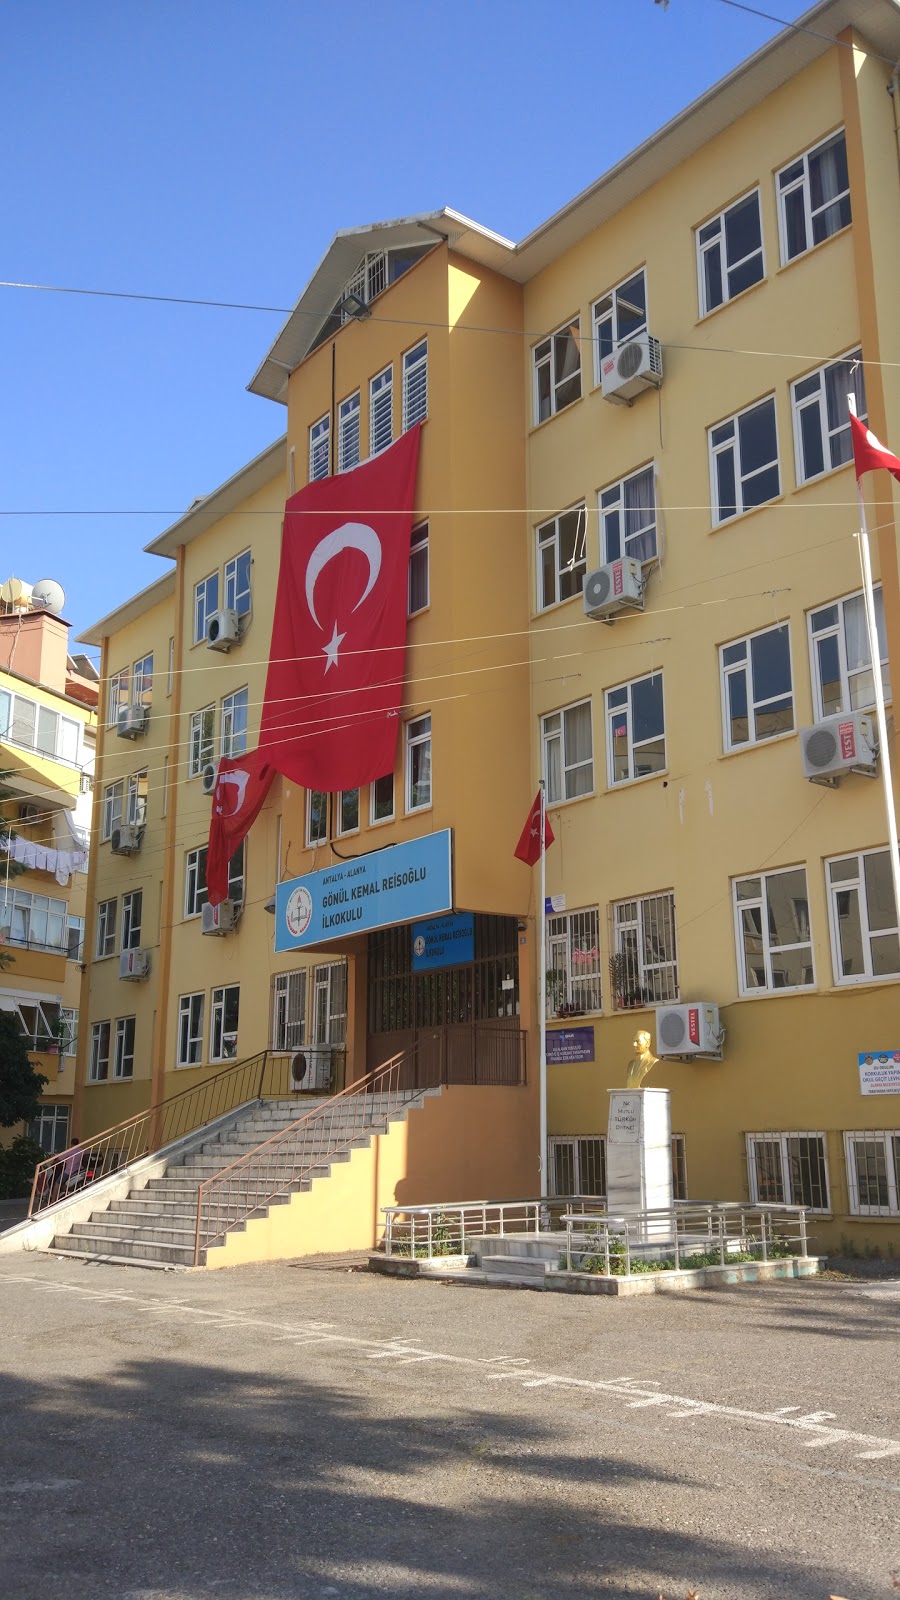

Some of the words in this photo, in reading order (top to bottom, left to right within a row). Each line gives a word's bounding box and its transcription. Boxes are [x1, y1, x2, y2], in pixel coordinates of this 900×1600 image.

[322, 874, 343, 886] ANTALYA
[347, 866, 366, 879] ALANYA
[322, 889, 349, 908] GÖNÜL
[351, 885, 379, 901] KEMAL
[382, 867, 426, 891] REİSOĞLU
[322, 907, 363, 929] İLKOKULU
